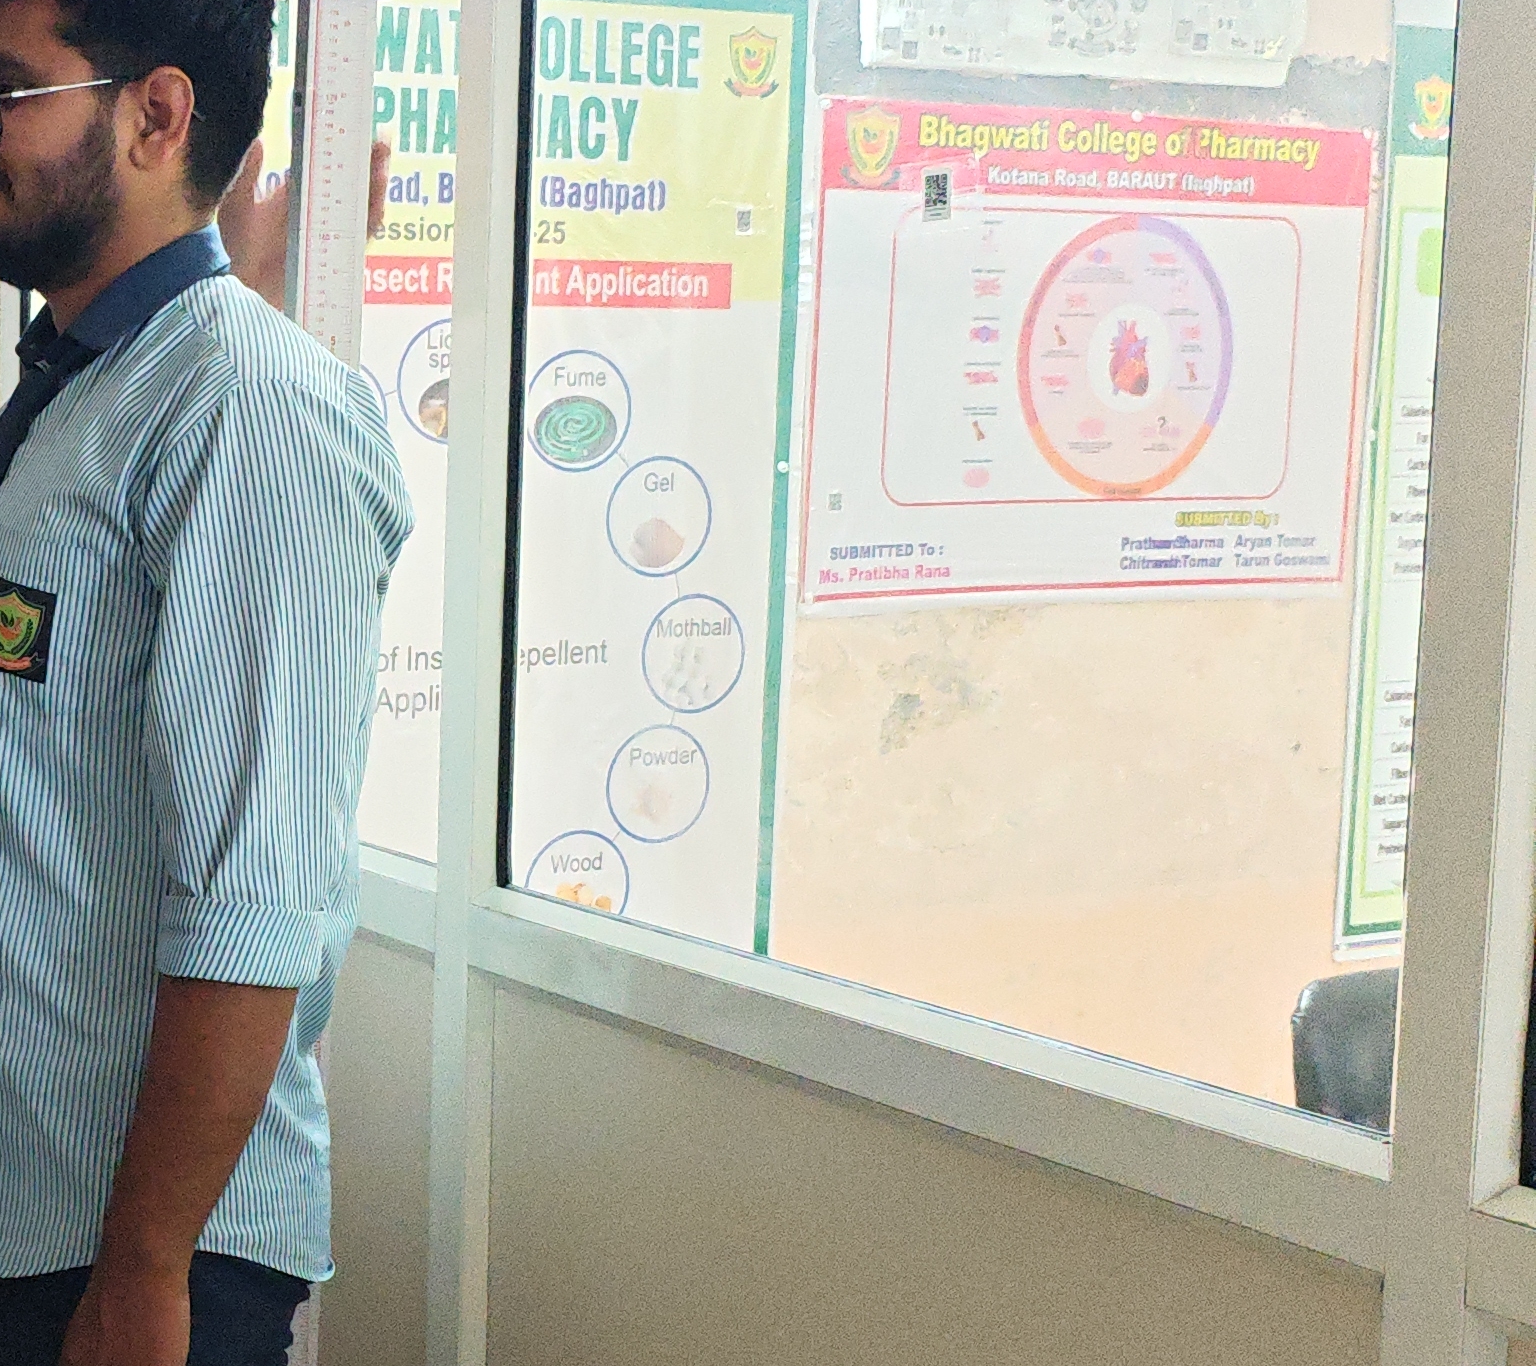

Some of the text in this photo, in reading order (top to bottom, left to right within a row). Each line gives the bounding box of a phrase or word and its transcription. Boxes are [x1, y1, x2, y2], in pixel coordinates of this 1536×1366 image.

[539, 16, 700, 89] OLLEGE
[919, 115, 1050, 159] Bhagwati
[1058, 123, 1157, 163] College
[987, 168, 1048, 188] Kotana
[1106, 170, 1177, 191] BARAUT
[539, 175, 666, 215] (Baghpat)
[365, 262, 430, 294] nsect
[565, 264, 710, 303] Application
[553, 366, 607, 387] Fume
[643, 472, 675, 494] Gel
[829, 544, 914, 561] SUBMITTED
[1234, 553, 1271, 567] Tarun
[819, 569, 844, 585] Ms.
[914, 564, 951, 579] Rana
[656, 617, 733, 639] Mothball
[629, 746, 698, 768] Powder
[550, 853, 604, 875] Wood
